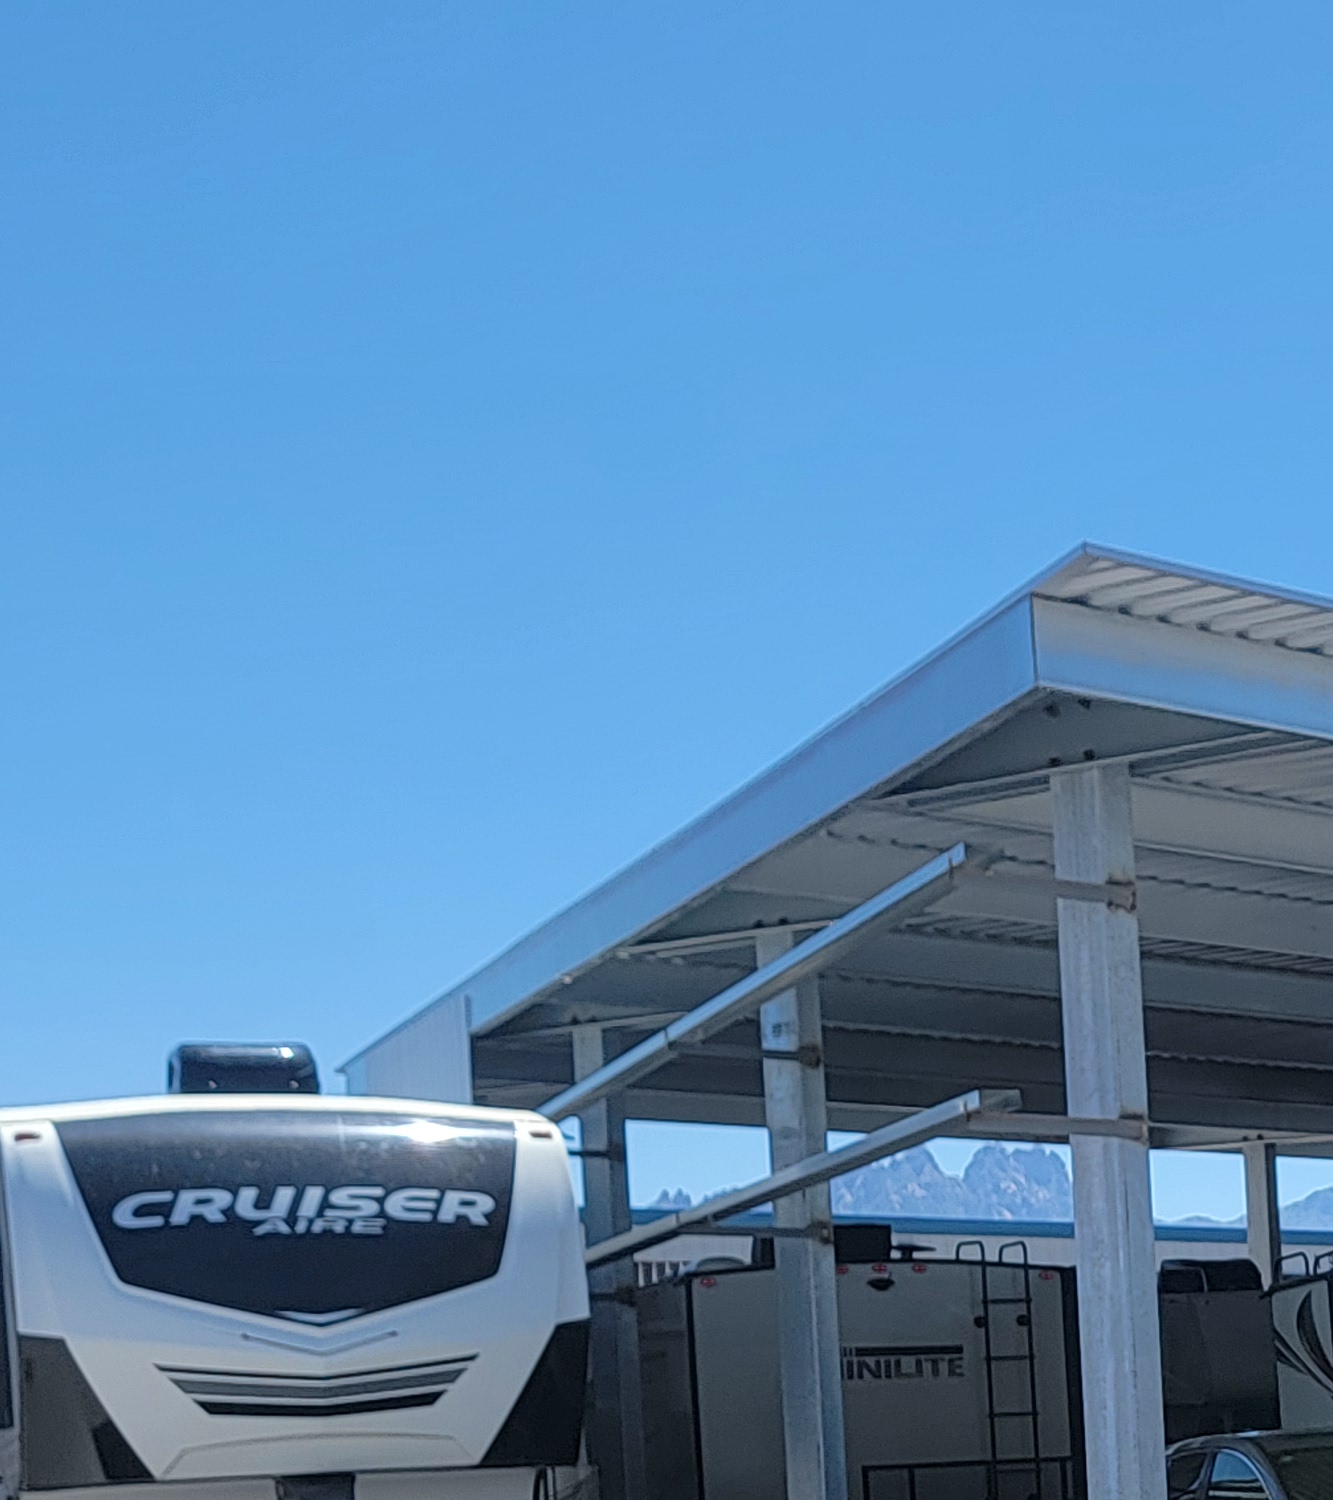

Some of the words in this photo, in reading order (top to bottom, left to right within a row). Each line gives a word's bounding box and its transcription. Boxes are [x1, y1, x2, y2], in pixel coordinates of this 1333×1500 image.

[110, 1184, 498, 1229] CRUISER
[251, 1216, 387, 1237] AIRE
[845, 1356, 966, 1380] INILITE
